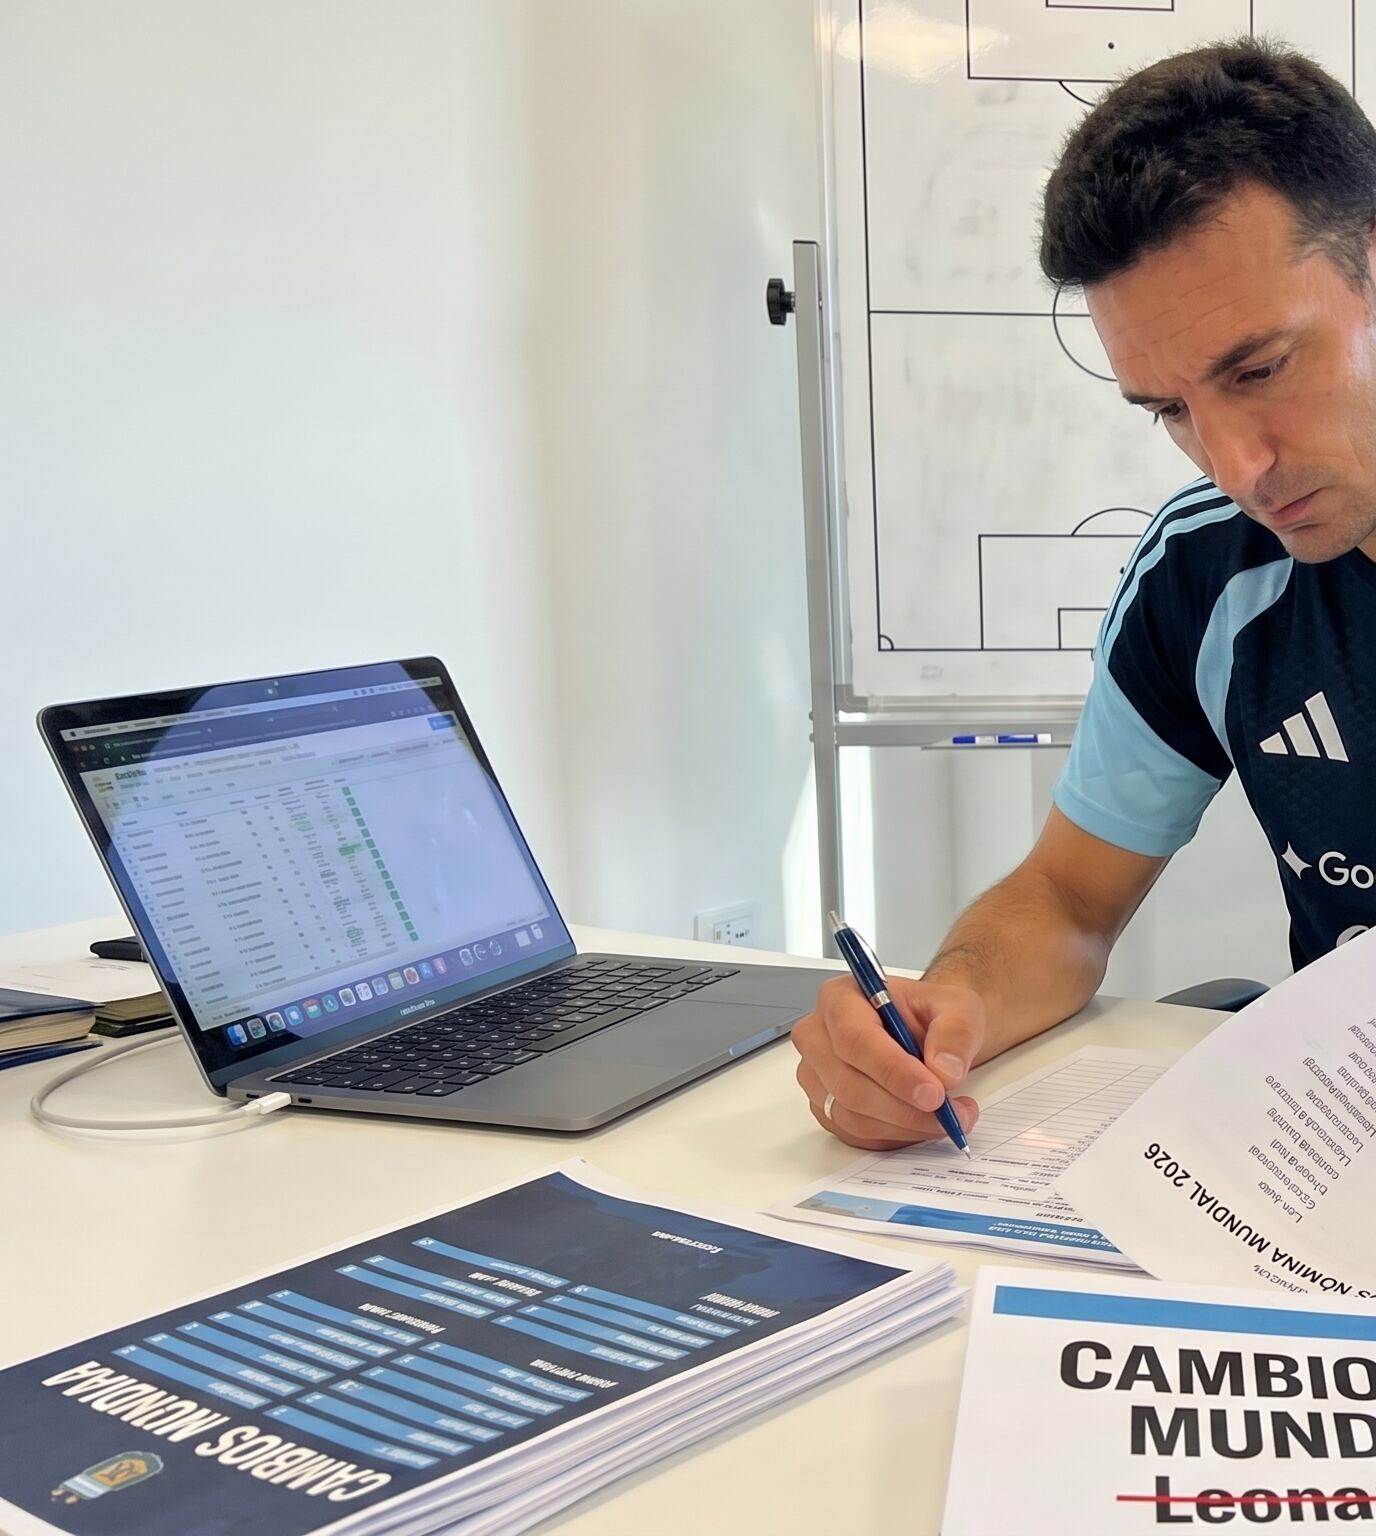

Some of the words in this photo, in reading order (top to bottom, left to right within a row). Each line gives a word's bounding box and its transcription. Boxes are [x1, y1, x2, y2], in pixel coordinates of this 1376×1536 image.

[1144, 1143, 1191, 1188] 2026
[1189, 1180, 1271, 1254] MUNDIAL
[194, 1425, 392, 1502] CAMBIOS
